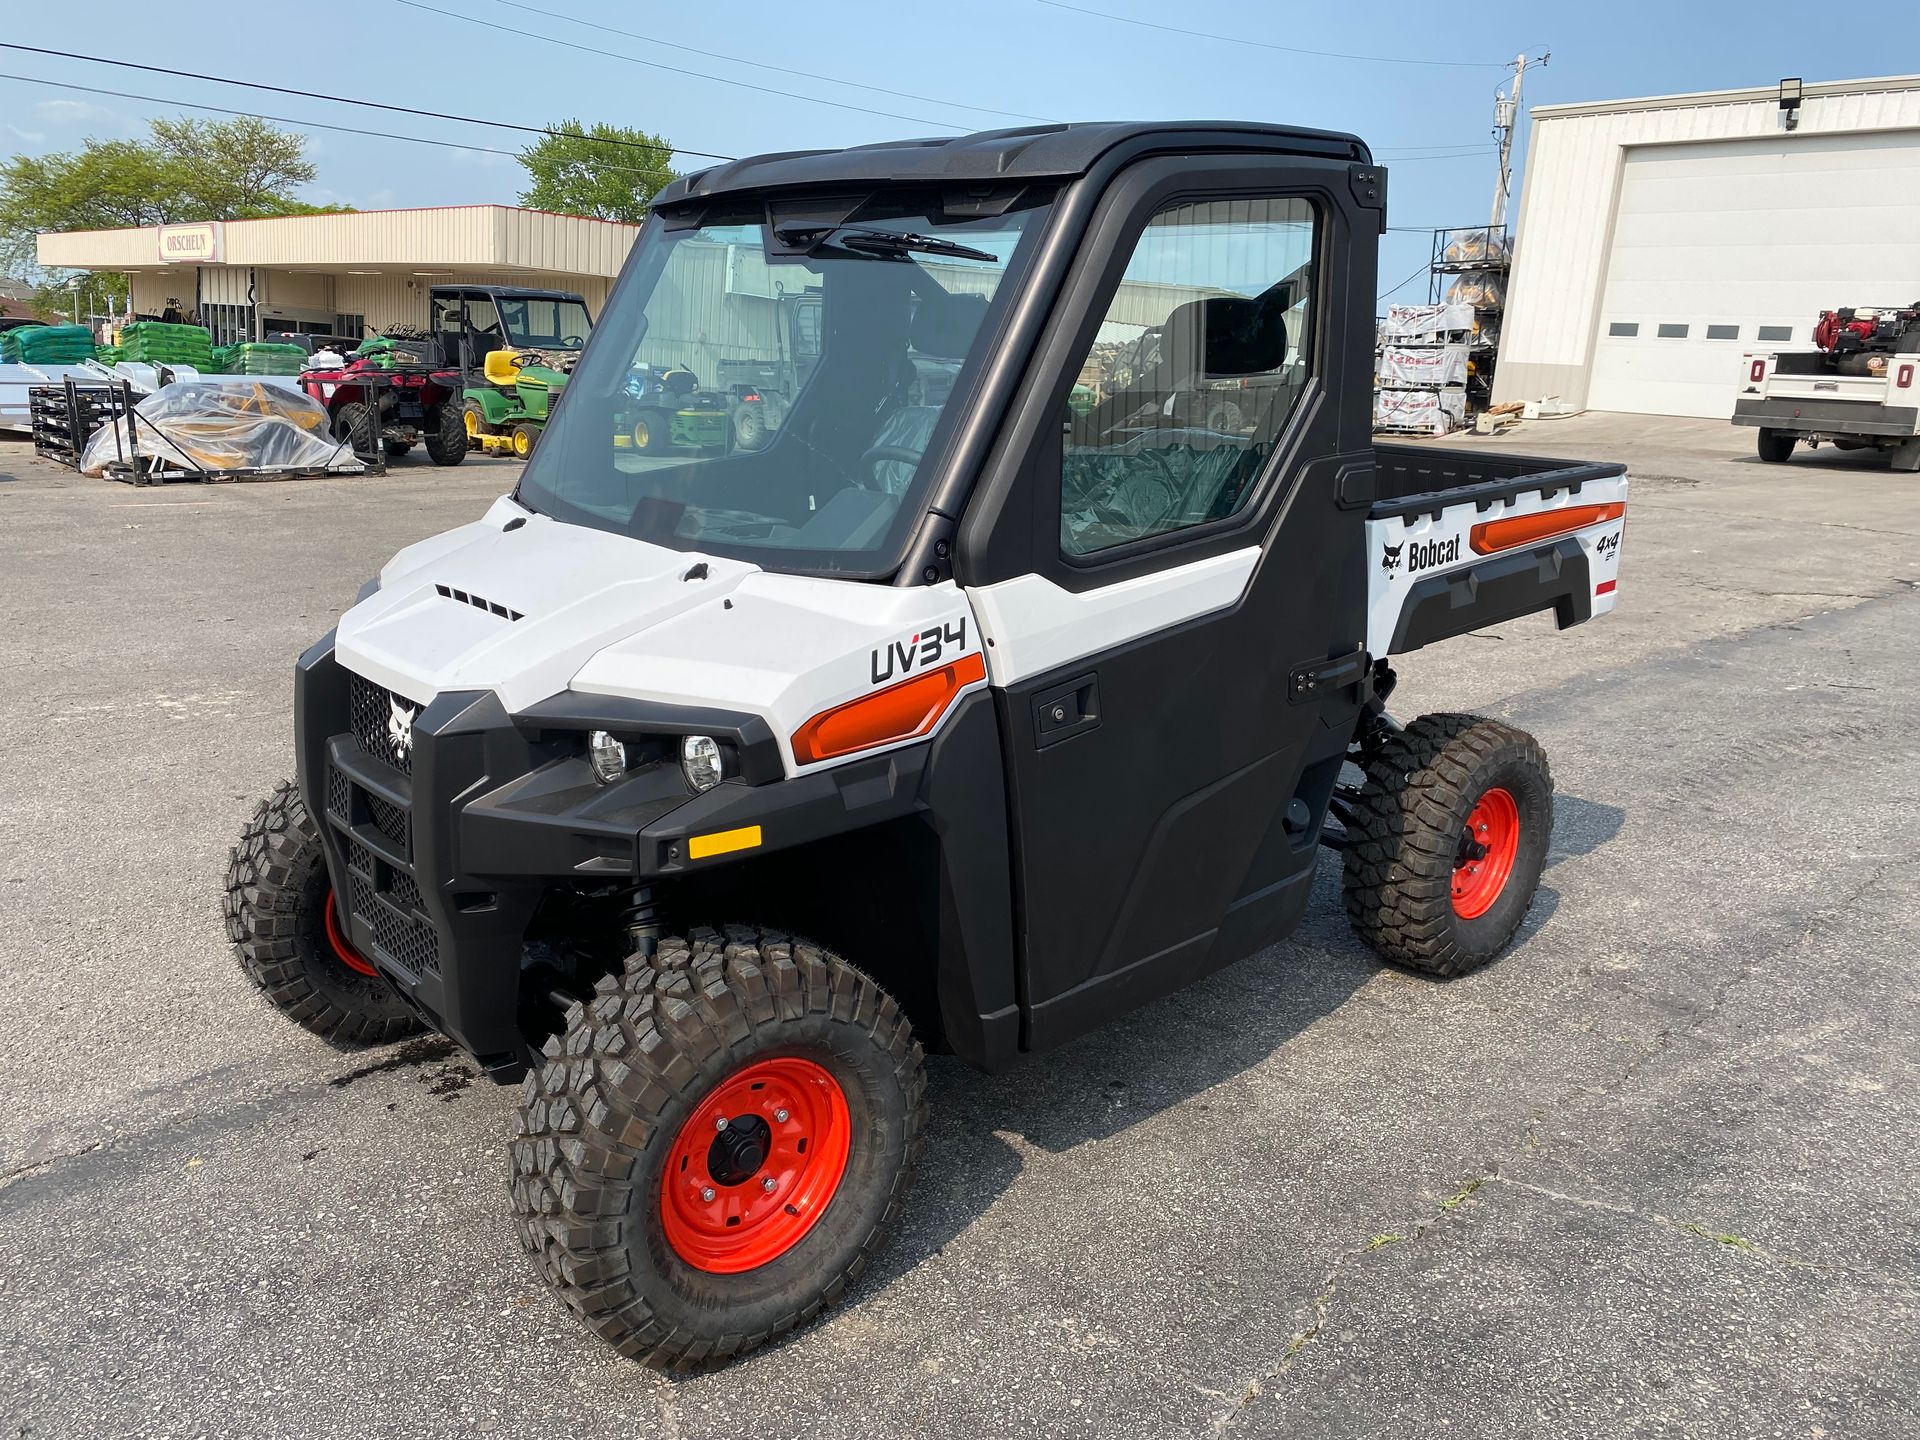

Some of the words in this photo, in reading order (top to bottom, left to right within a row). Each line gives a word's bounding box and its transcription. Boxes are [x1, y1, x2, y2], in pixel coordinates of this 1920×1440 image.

[1408, 533, 1460, 573] Bobcat
[1596, 531, 1620, 554] 4x4
[871, 616, 966, 685] UV34
